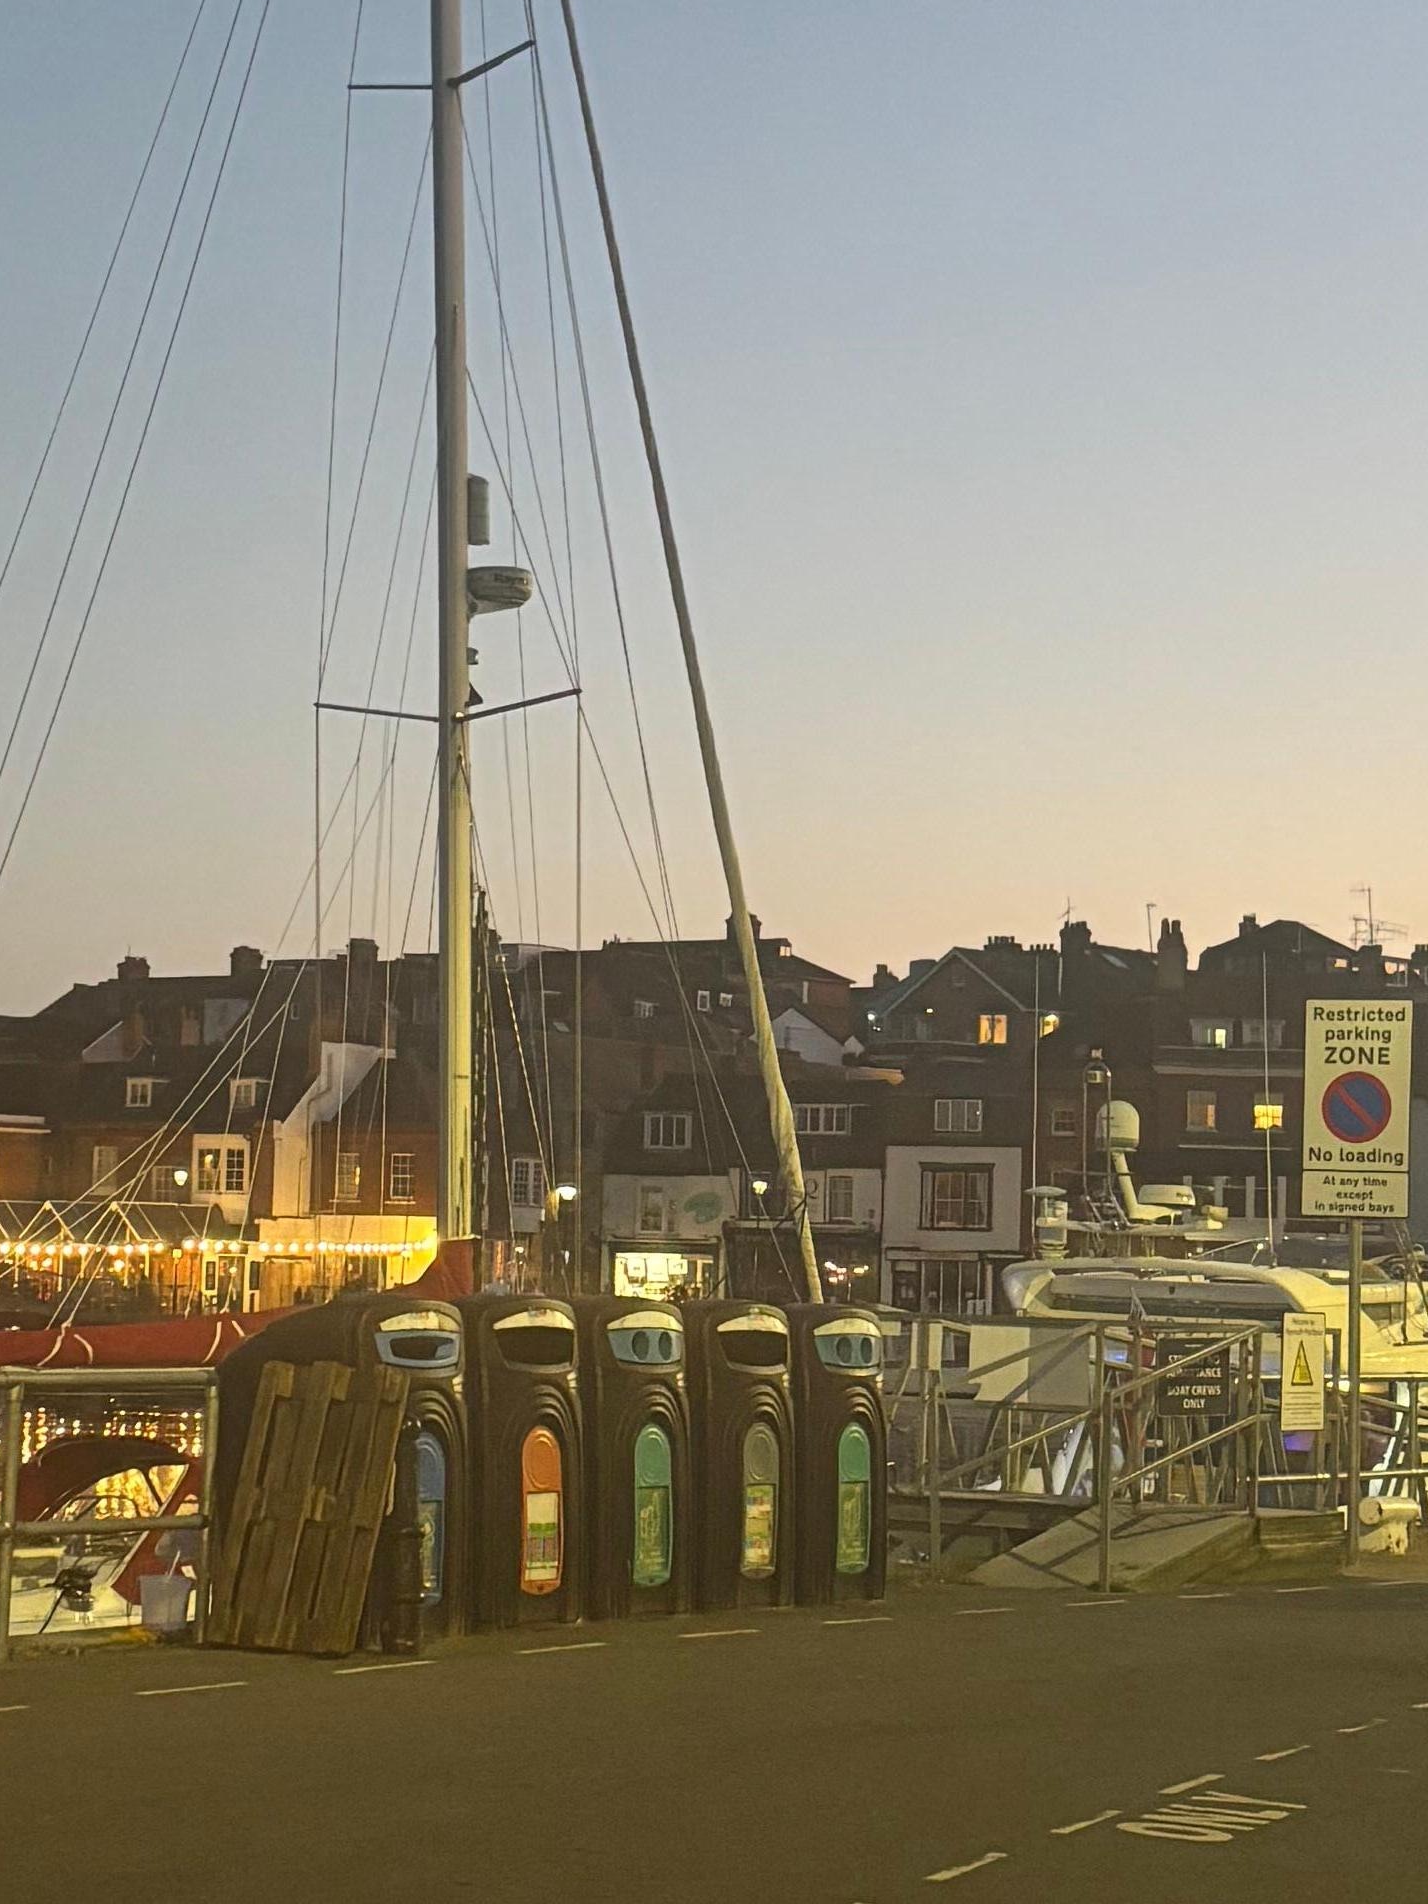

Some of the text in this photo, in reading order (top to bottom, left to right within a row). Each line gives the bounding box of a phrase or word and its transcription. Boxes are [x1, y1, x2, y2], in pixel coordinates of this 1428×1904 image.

[1313, 1006, 1406, 1022] Restricted
[1325, 1026, 1392, 1044] parking
[1324, 1046, 1391, 1065] ZONE
[1308, 1146, 1404, 1166] No loading
[1322, 1175, 1388, 1188] At any time
[1336, 1190, 1374, 1201] except
[1328, 1201, 1365, 1213] signed
[1368, 1203, 1395, 1214] bays
[1183, 1398, 1206, 1409] ONLY
[1116, 1790, 1308, 1842] ONLY
